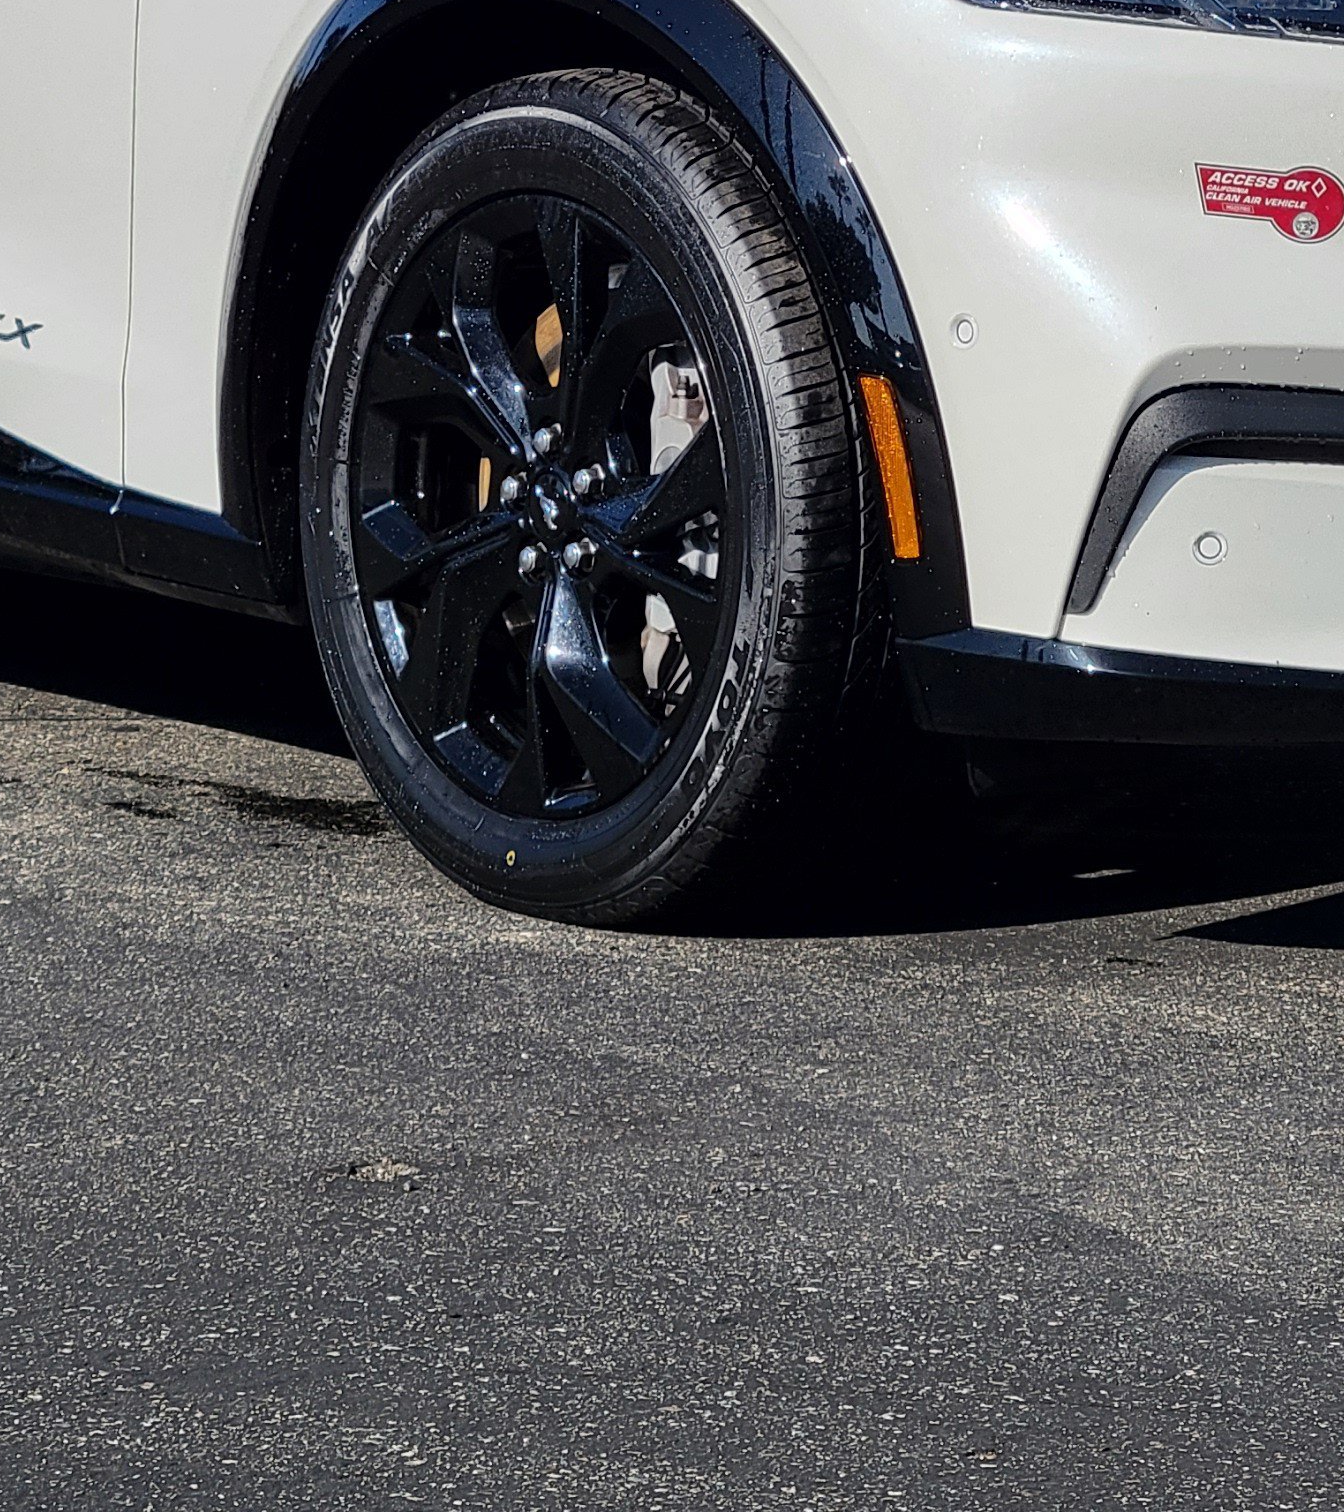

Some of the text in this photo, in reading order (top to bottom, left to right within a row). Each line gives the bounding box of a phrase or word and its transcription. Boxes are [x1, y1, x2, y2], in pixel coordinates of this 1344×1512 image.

[1206, 184, 1249, 195] CALIFORNIA
[1208, 171, 1311, 192] ACCESS OK
[1206, 191, 1242, 203] CLEAN
[1243, 195, 1262, 206] AIR
[1265, 197, 1308, 210] VEHICLE
